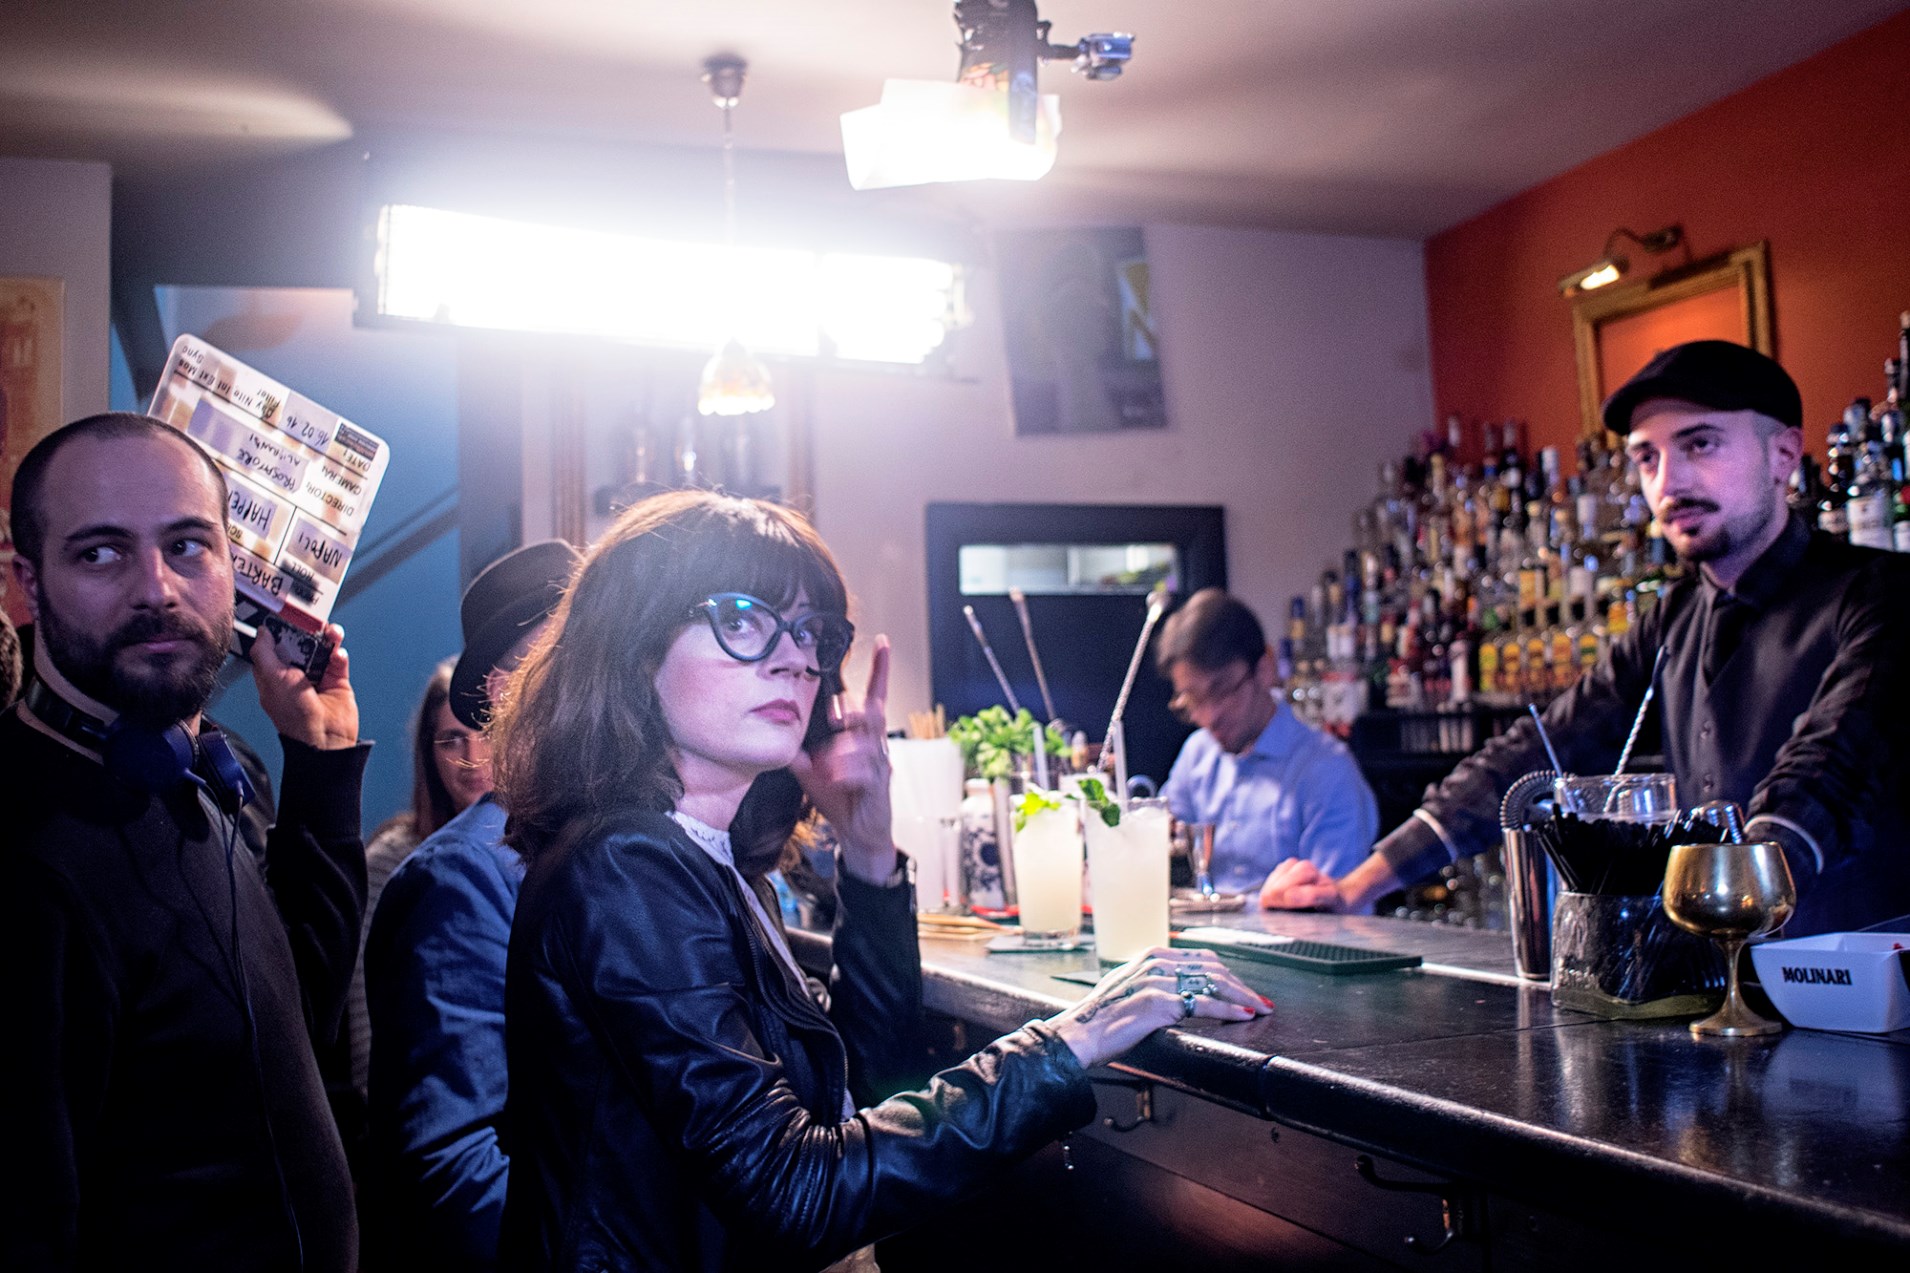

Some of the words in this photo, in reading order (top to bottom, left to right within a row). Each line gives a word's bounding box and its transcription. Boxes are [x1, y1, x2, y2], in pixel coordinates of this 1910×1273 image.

[182, 344, 204, 364] Sync
[198, 369, 215, 387] Ext
[216, 378, 232, 395] Int
[233, 388, 253, 407] Nite
[296, 529, 344, 570] NAPOLI
[1782, 966, 1852, 986] MOLINARI
